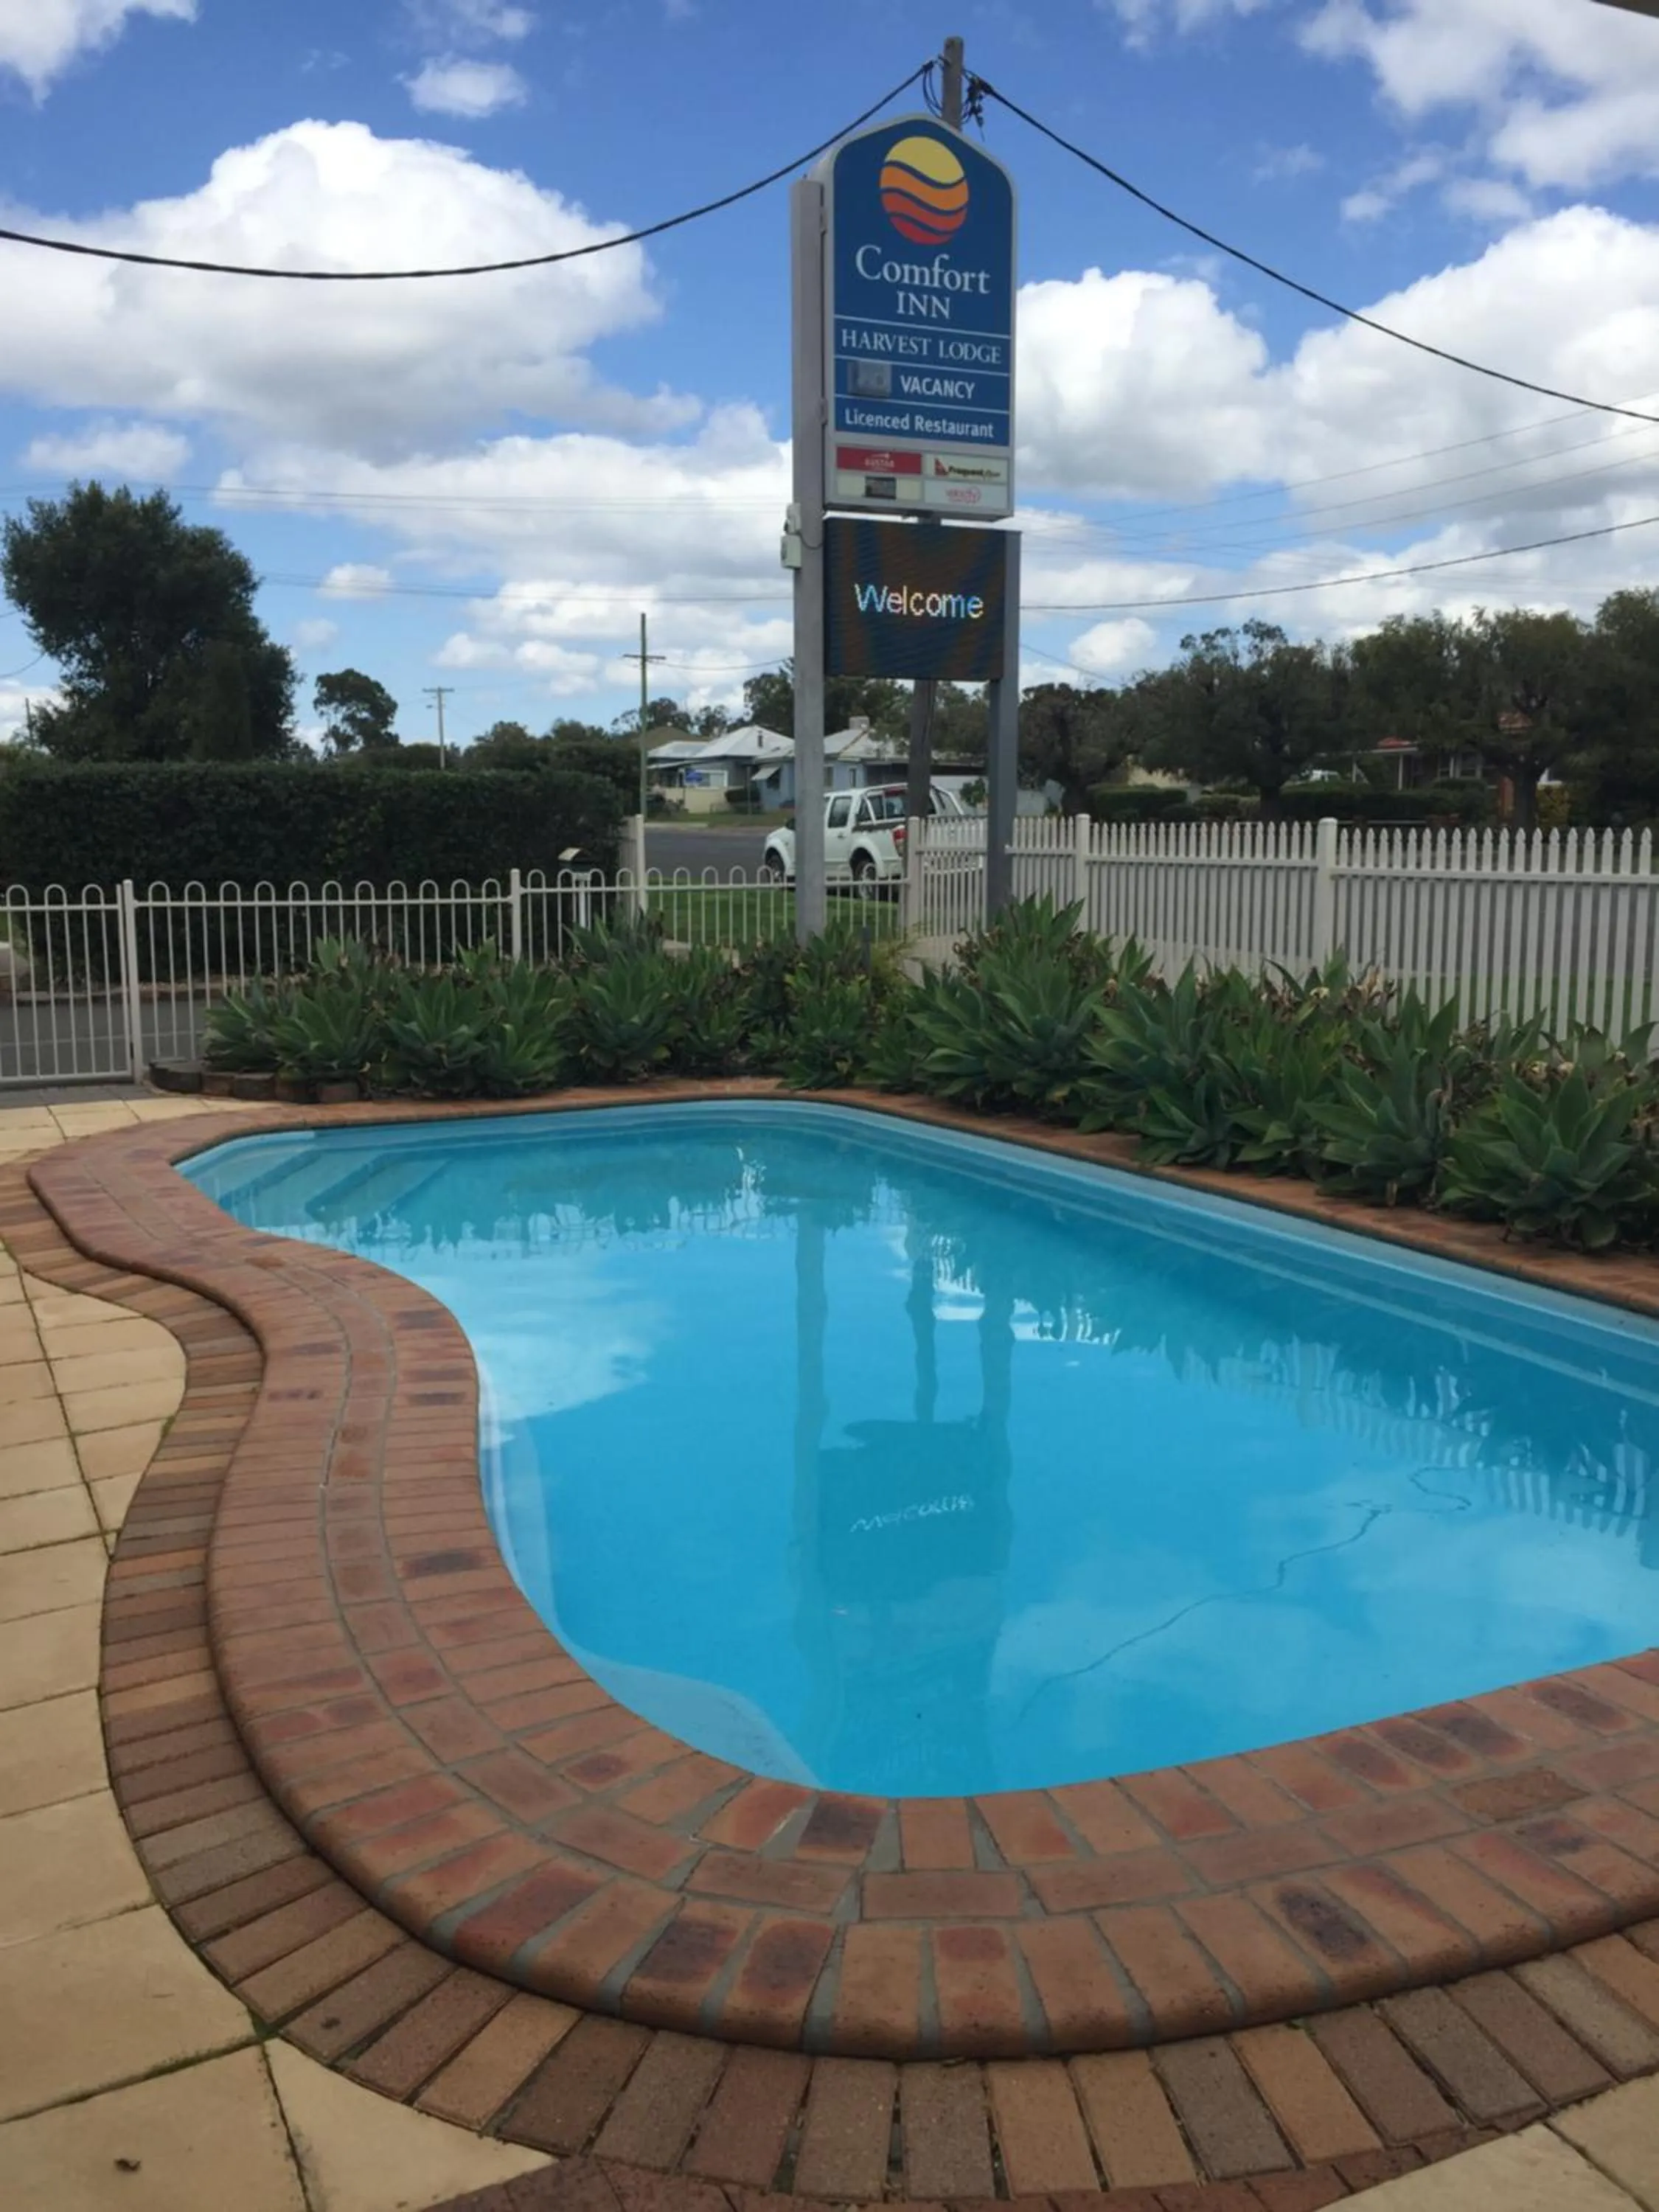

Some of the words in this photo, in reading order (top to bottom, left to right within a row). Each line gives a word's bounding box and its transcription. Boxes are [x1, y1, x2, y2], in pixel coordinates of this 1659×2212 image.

[855, 244, 991, 294] Comfort
[896, 291, 950, 319] INN
[841, 329, 932, 356] HARVEST
[938, 339, 1002, 364] LODGE
[899, 375, 975, 400] VACANCY
[844, 408, 910, 430] Licenced
[914, 414, 995, 439] Restaurant
[854, 582, 984, 619] Welcome
